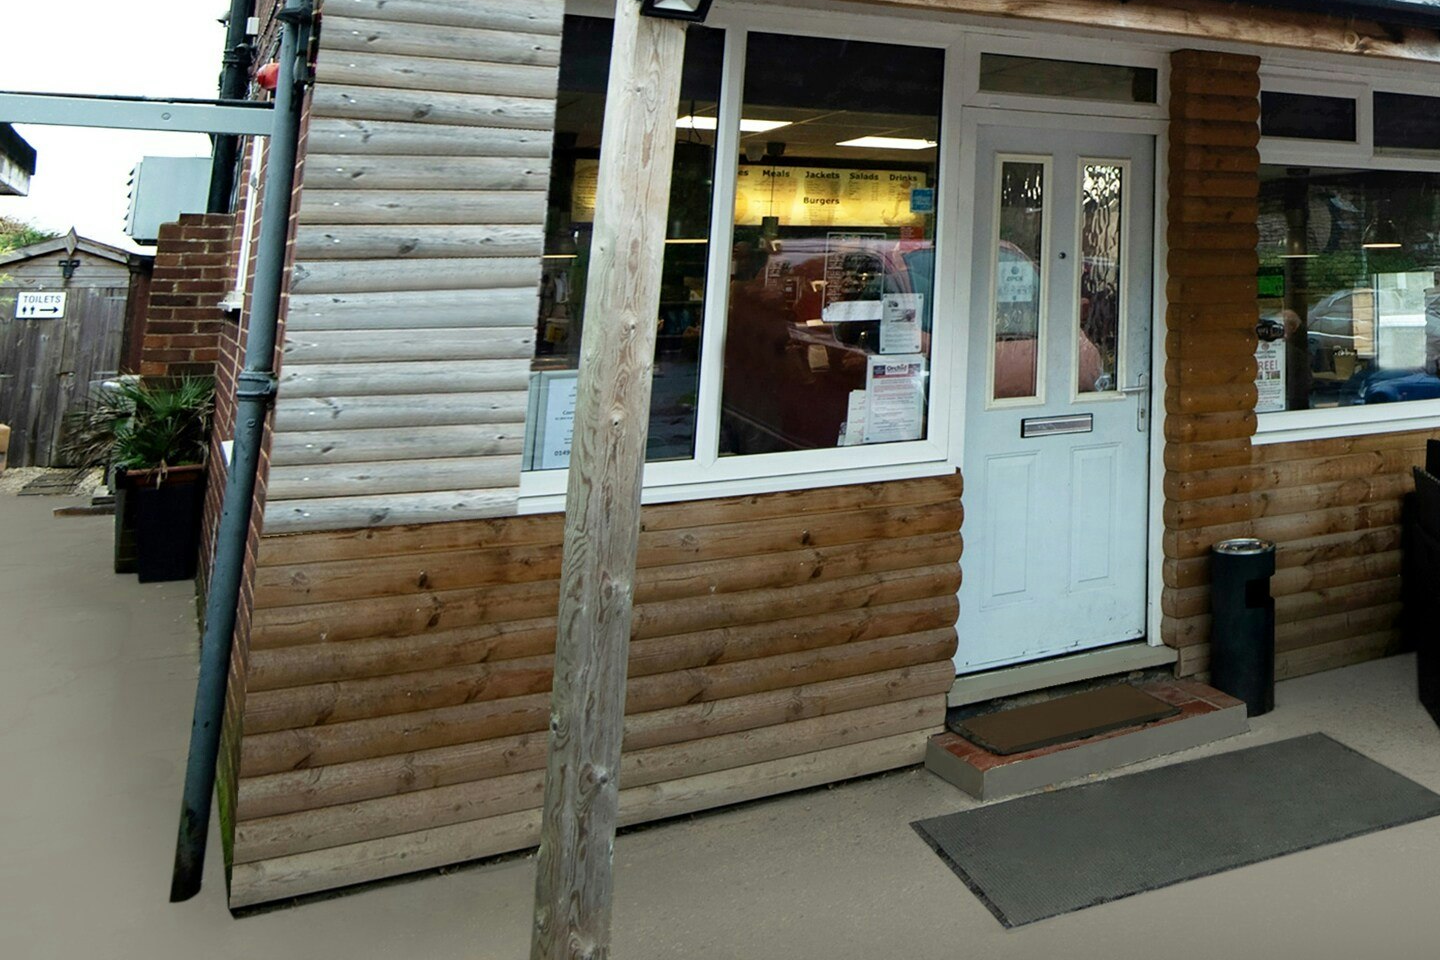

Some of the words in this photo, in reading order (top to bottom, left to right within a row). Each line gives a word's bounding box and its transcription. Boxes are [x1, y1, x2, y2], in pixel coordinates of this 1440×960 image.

[762, 170, 790, 178] Meals
[805, 171, 840, 179] Jackets
[849, 172, 879, 181] Salads
[889, 173, 918, 182] Drinks
[803, 196, 840, 205] Burgers
[23, 295, 61, 304] TOILETS
[1258, 360, 1278, 371] REE!
